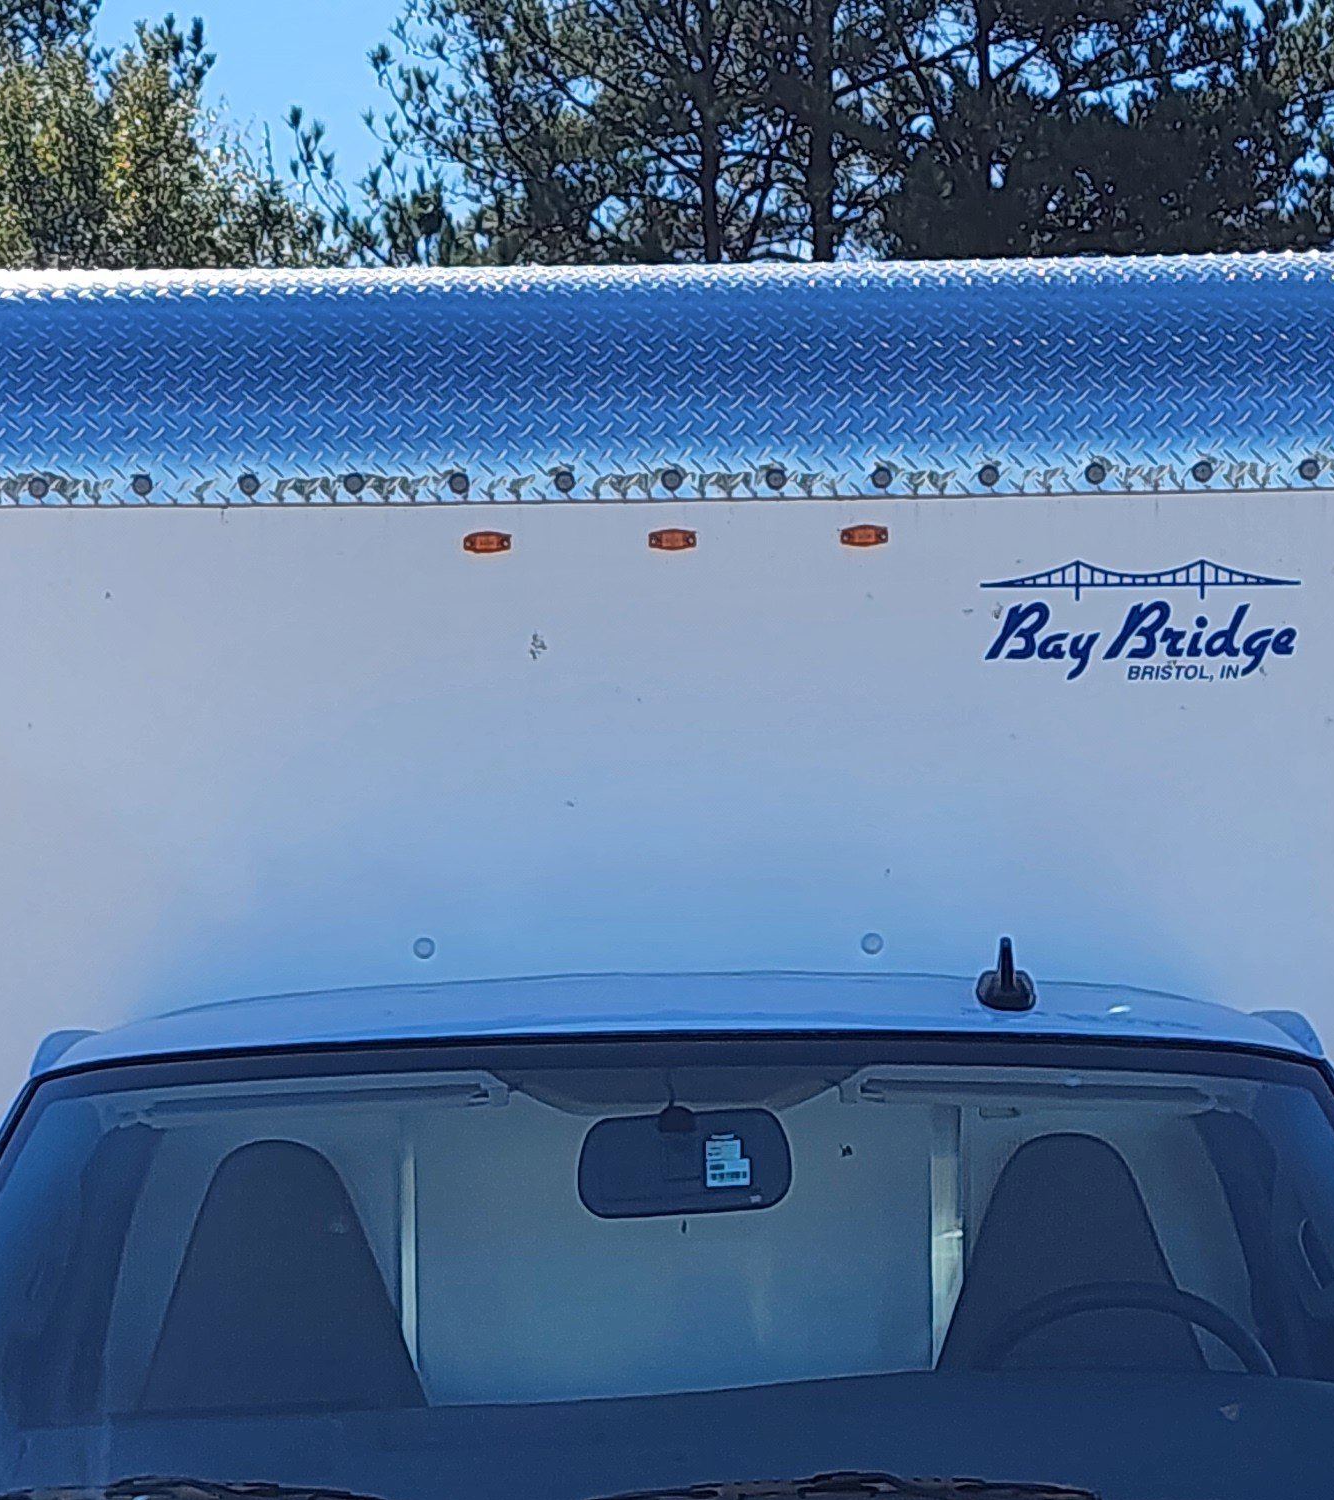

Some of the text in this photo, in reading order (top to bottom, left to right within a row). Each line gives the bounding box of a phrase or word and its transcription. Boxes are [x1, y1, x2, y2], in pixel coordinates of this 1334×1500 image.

[985, 601, 1297, 680] Bay Bridge
[1127, 659, 1239, 682] BRISTOL, IN
